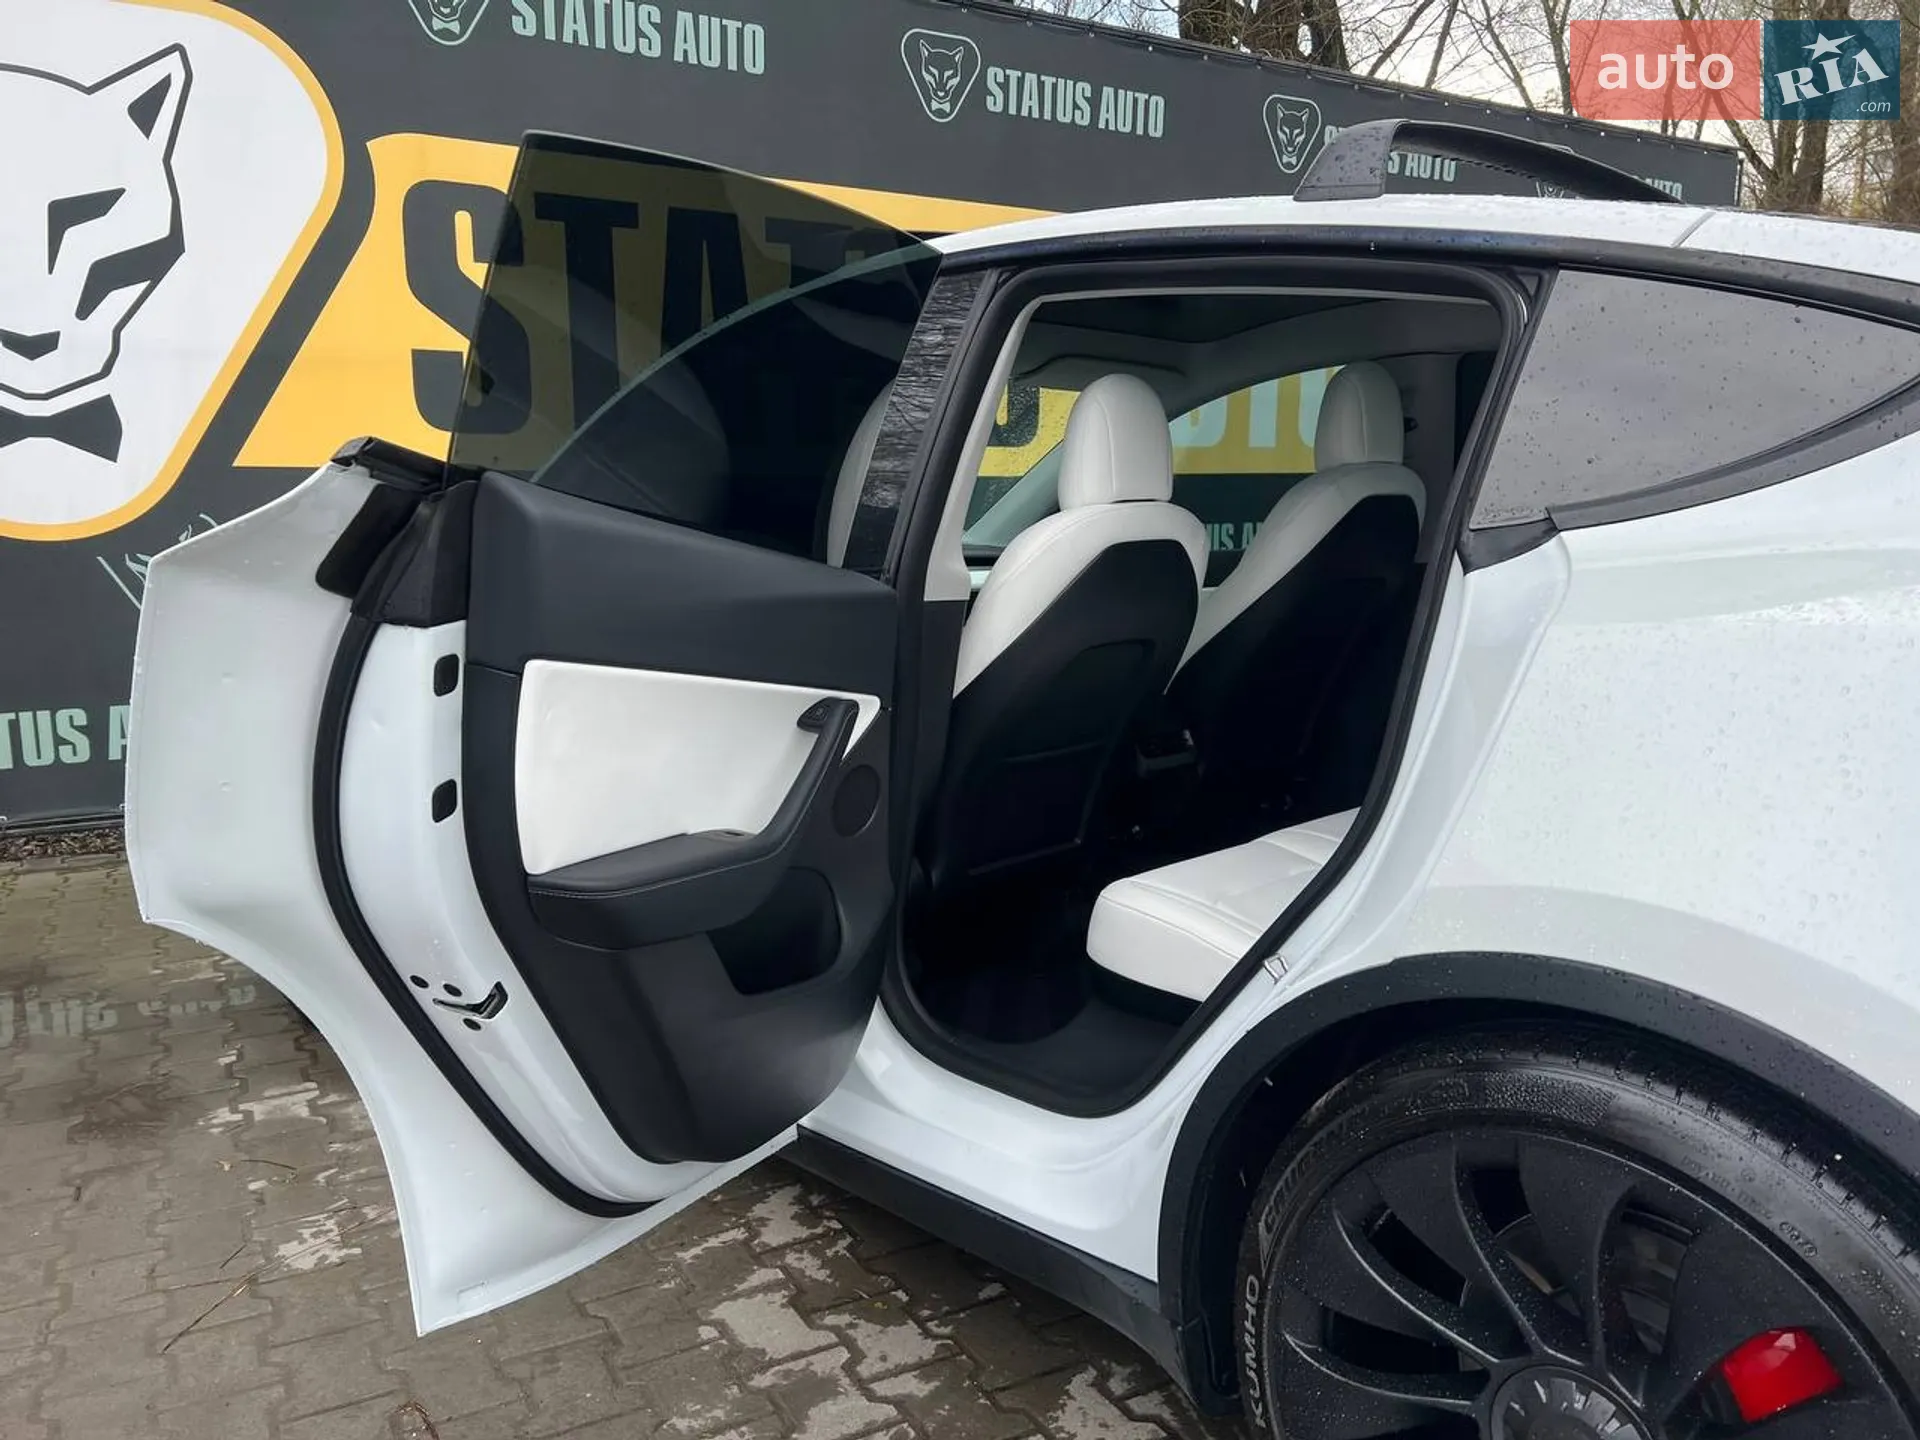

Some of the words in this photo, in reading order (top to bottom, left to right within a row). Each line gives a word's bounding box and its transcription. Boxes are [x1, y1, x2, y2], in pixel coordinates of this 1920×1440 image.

[511, 0, 661, 58] STATUS
[673, 10, 765, 75] AUTO
[986, 66, 1092, 126] STATUS
[1098, 86, 1165, 138] AUTO
[1244, 1274, 1266, 1428] KUMHO
